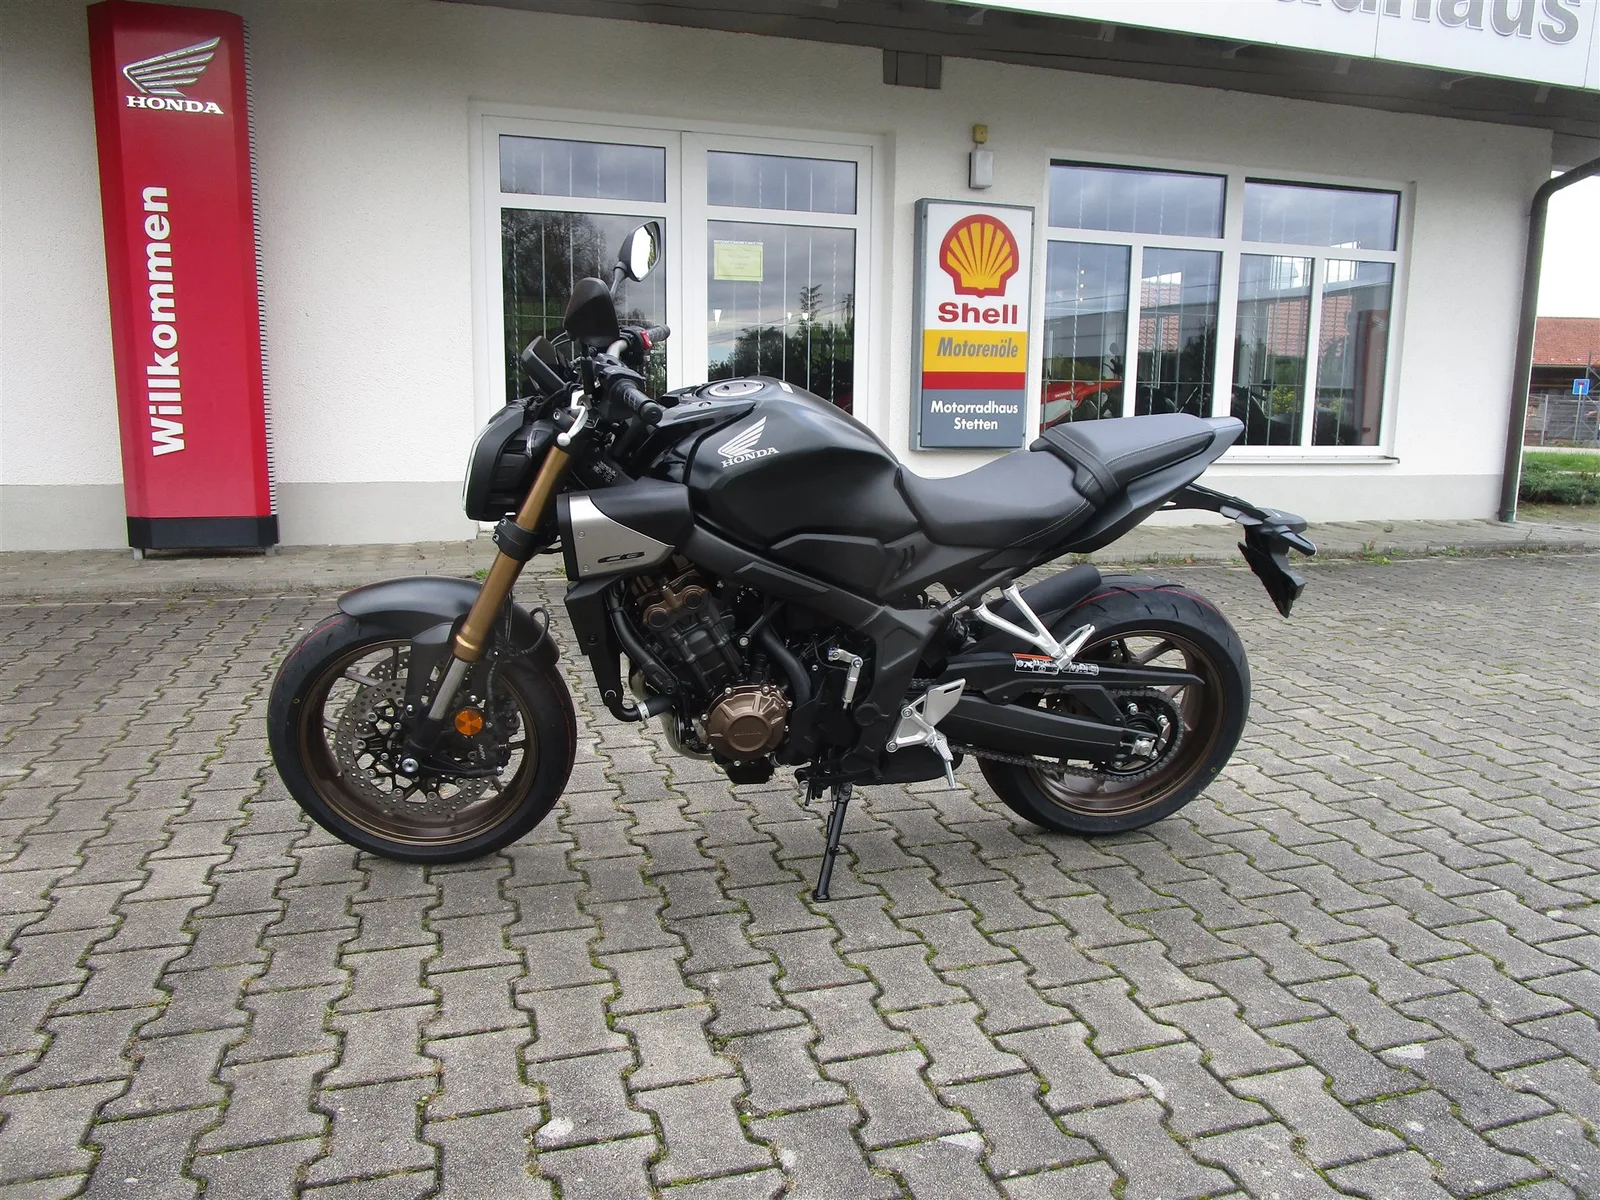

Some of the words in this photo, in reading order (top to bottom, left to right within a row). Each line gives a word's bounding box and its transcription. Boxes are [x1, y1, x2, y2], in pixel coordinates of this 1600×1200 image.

[126, 95, 224, 114] HONDA
[142, 186, 185, 457] Willkommen
[938, 302, 1018, 324] Shell
[937, 337, 1019, 358] Motorenöle
[930, 401, 1019, 414] Motorradhaus
[953, 417, 998, 430] Stetten
[721, 447, 780, 468] HONDA
